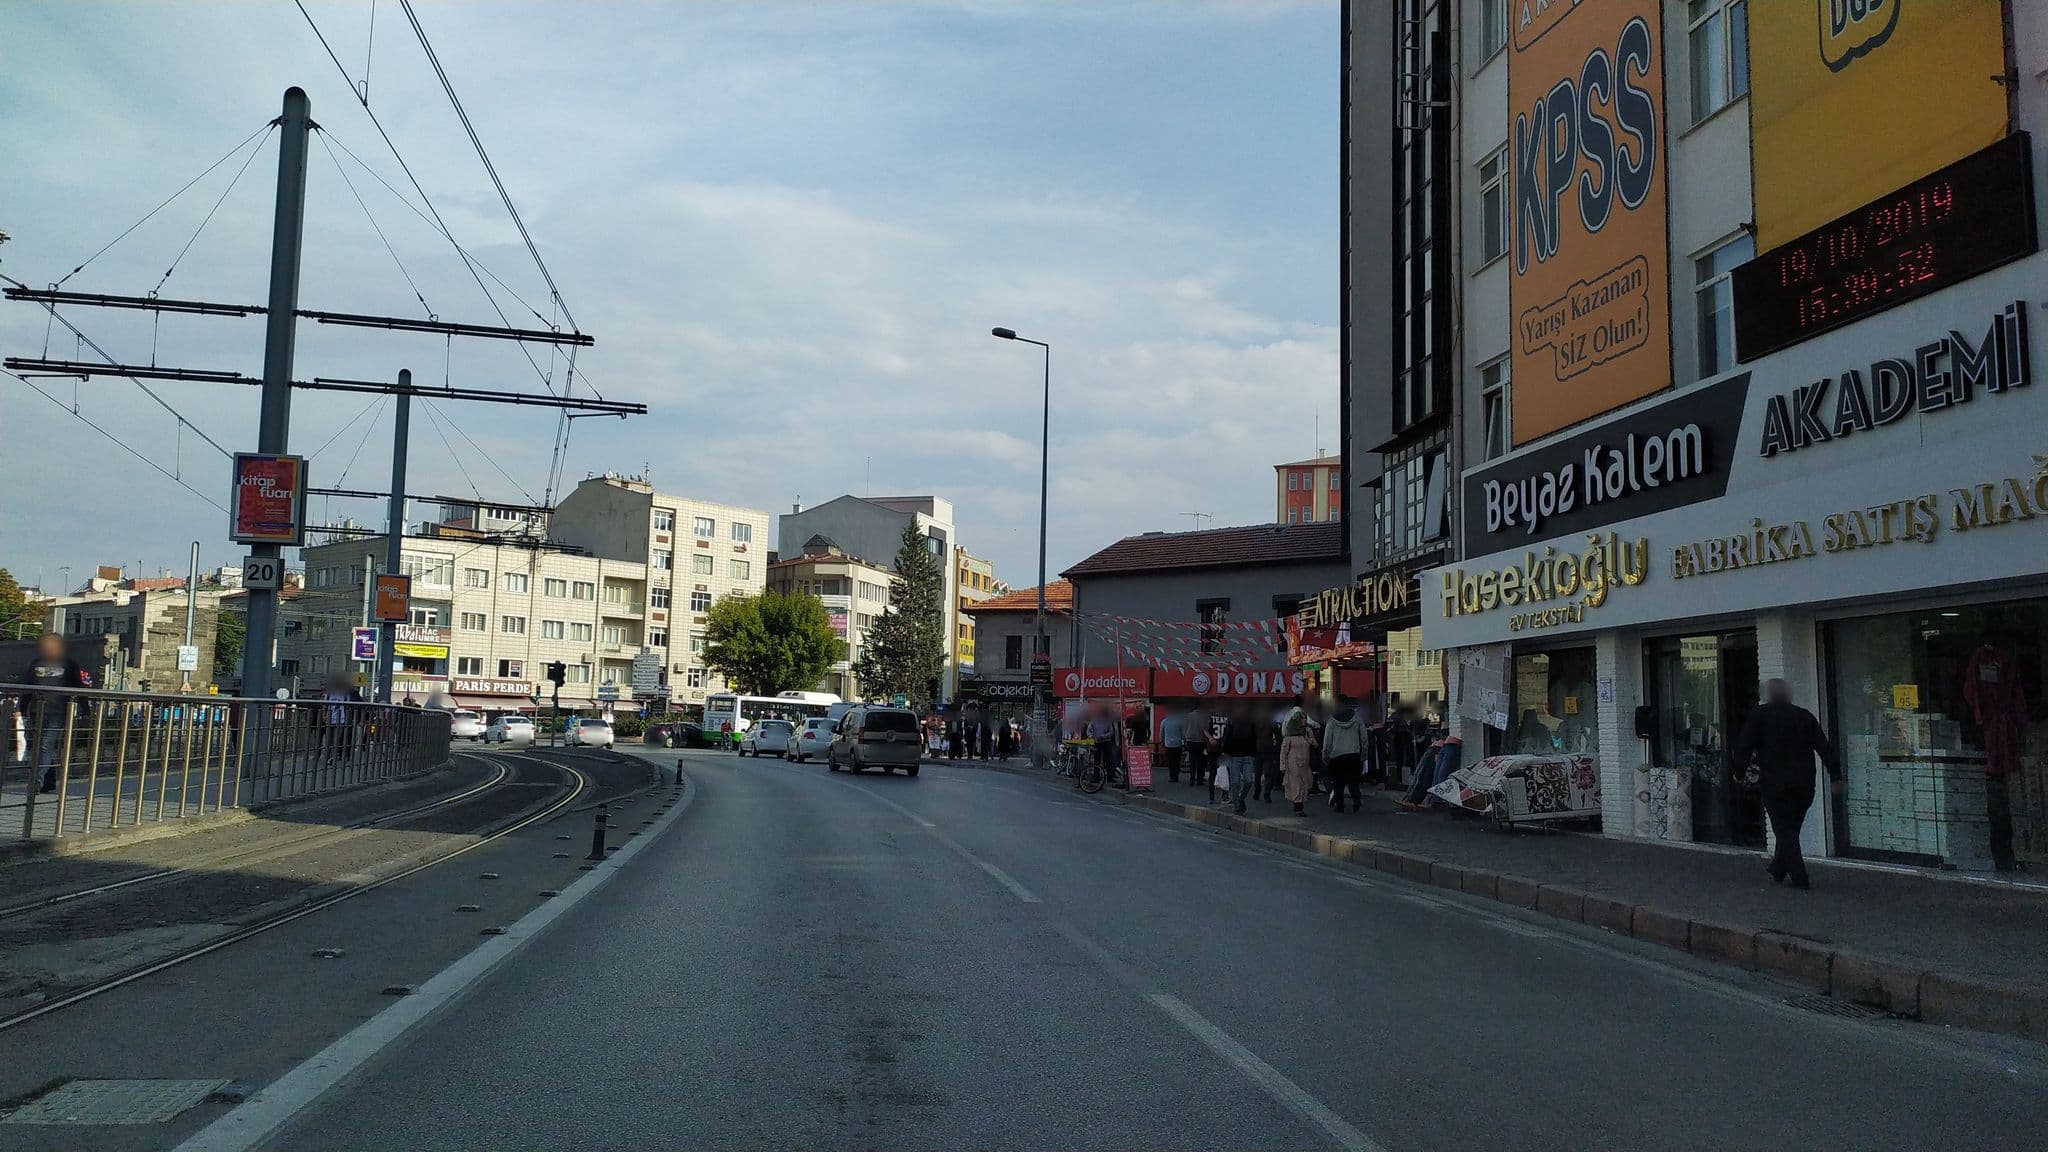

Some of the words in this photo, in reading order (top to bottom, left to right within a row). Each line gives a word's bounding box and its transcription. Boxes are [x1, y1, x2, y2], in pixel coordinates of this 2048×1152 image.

[1516, 16, 1656, 276] KPSS
[1781, 181, 1952, 287] 19/10/2019
[1525, 308, 1566, 344] Yarışı
[1571, 267, 1642, 321] Kazanan
[1799, 242, 1936, 328] 15:39:52
[1593, 306, 1642, 354] Olun!
[1759, 300, 2032, 458] AKADEMİ
[240, 474, 276, 489] kitap
[1483, 463, 1576, 535] Beyaz
[1669, 517, 1817, 579] FABRİKA
[1822, 493, 1939, 552] SATIŞ
[247, 563, 274, 581] 20
[1313, 571, 1408, 628] ATRACTION
[1440, 530, 1649, 618] Hasekioğlu
[1508, 611, 1525, 630] EV
[455, 679, 491, 693] PARİS
[493, 683, 531, 693] PERDE
[1082, 675, 1136, 689] vodafone
[1216, 671, 1305, 695] DONAS
